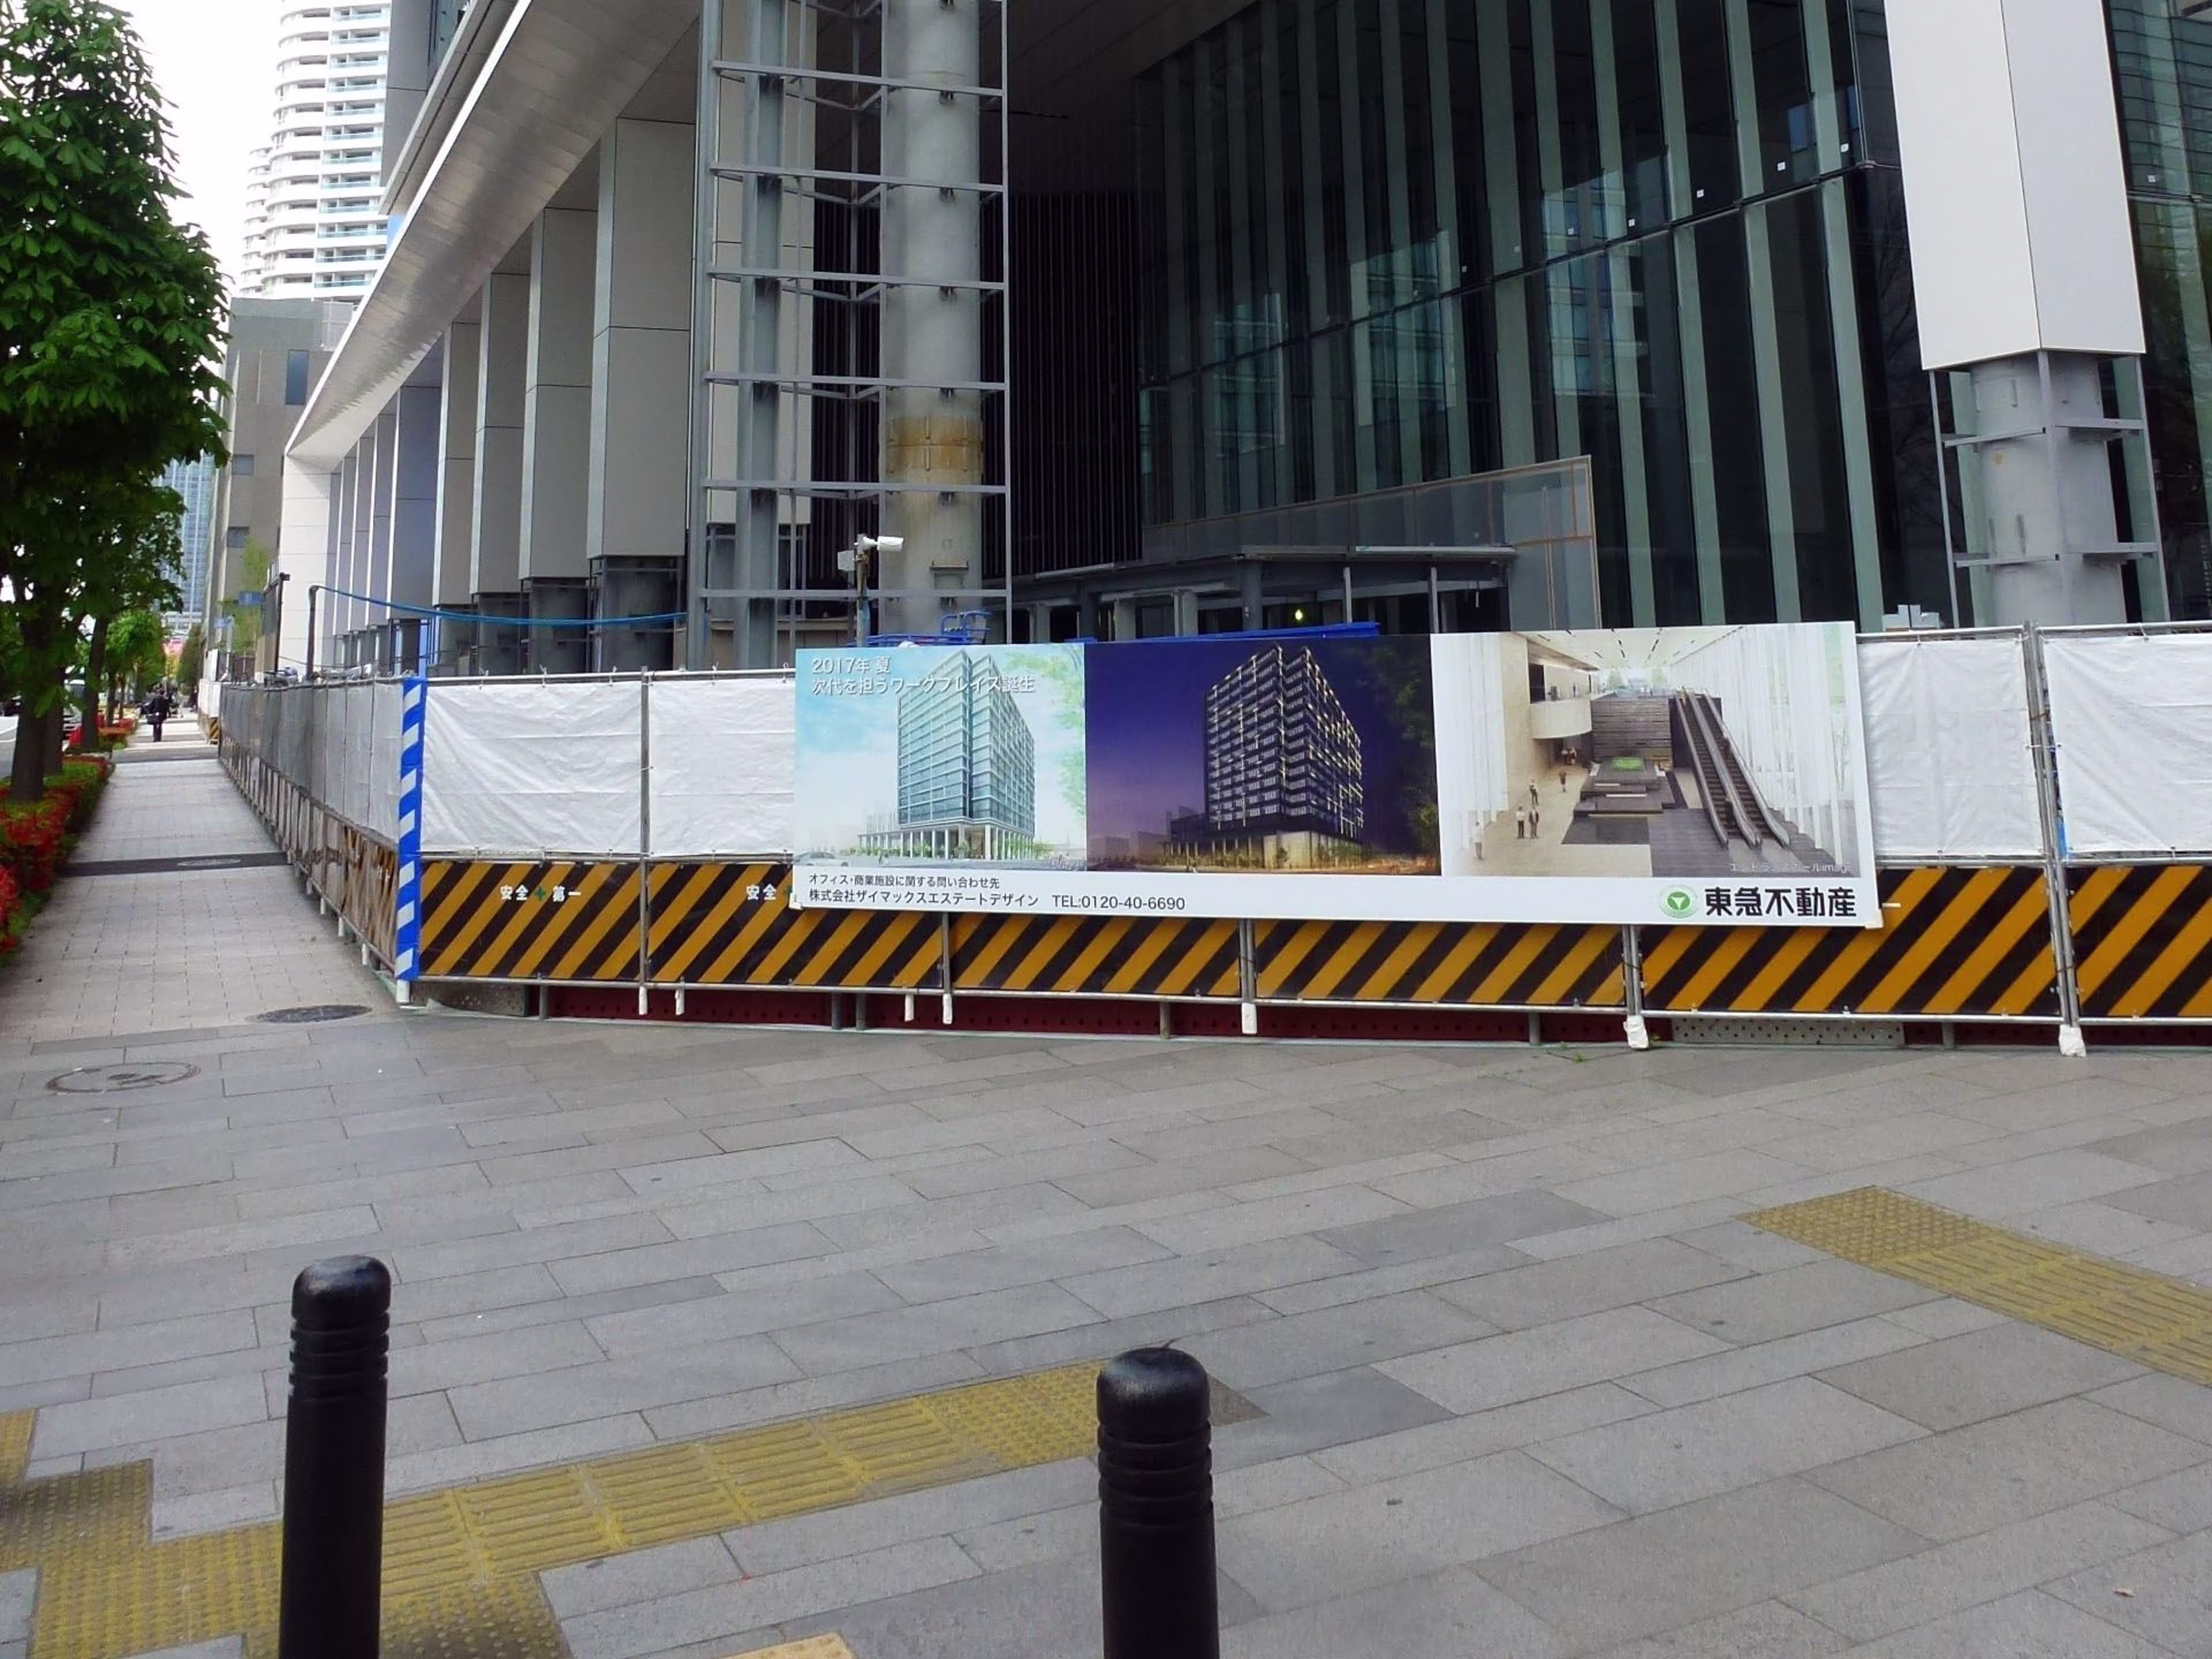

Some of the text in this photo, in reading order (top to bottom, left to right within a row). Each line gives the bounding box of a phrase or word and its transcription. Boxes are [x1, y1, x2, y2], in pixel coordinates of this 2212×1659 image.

[812, 656, 891, 674] 2017年 夏
[809, 873, 1000, 889] オフィス・商業施設に関する問い合わせ先
[746, 884, 777, 900] 安全
[809, 888, 1186, 911] 株式会社ザイマックスエステートデザイン TEL:0120-40-6690
[1705, 887, 1857, 916] 東急不動産
